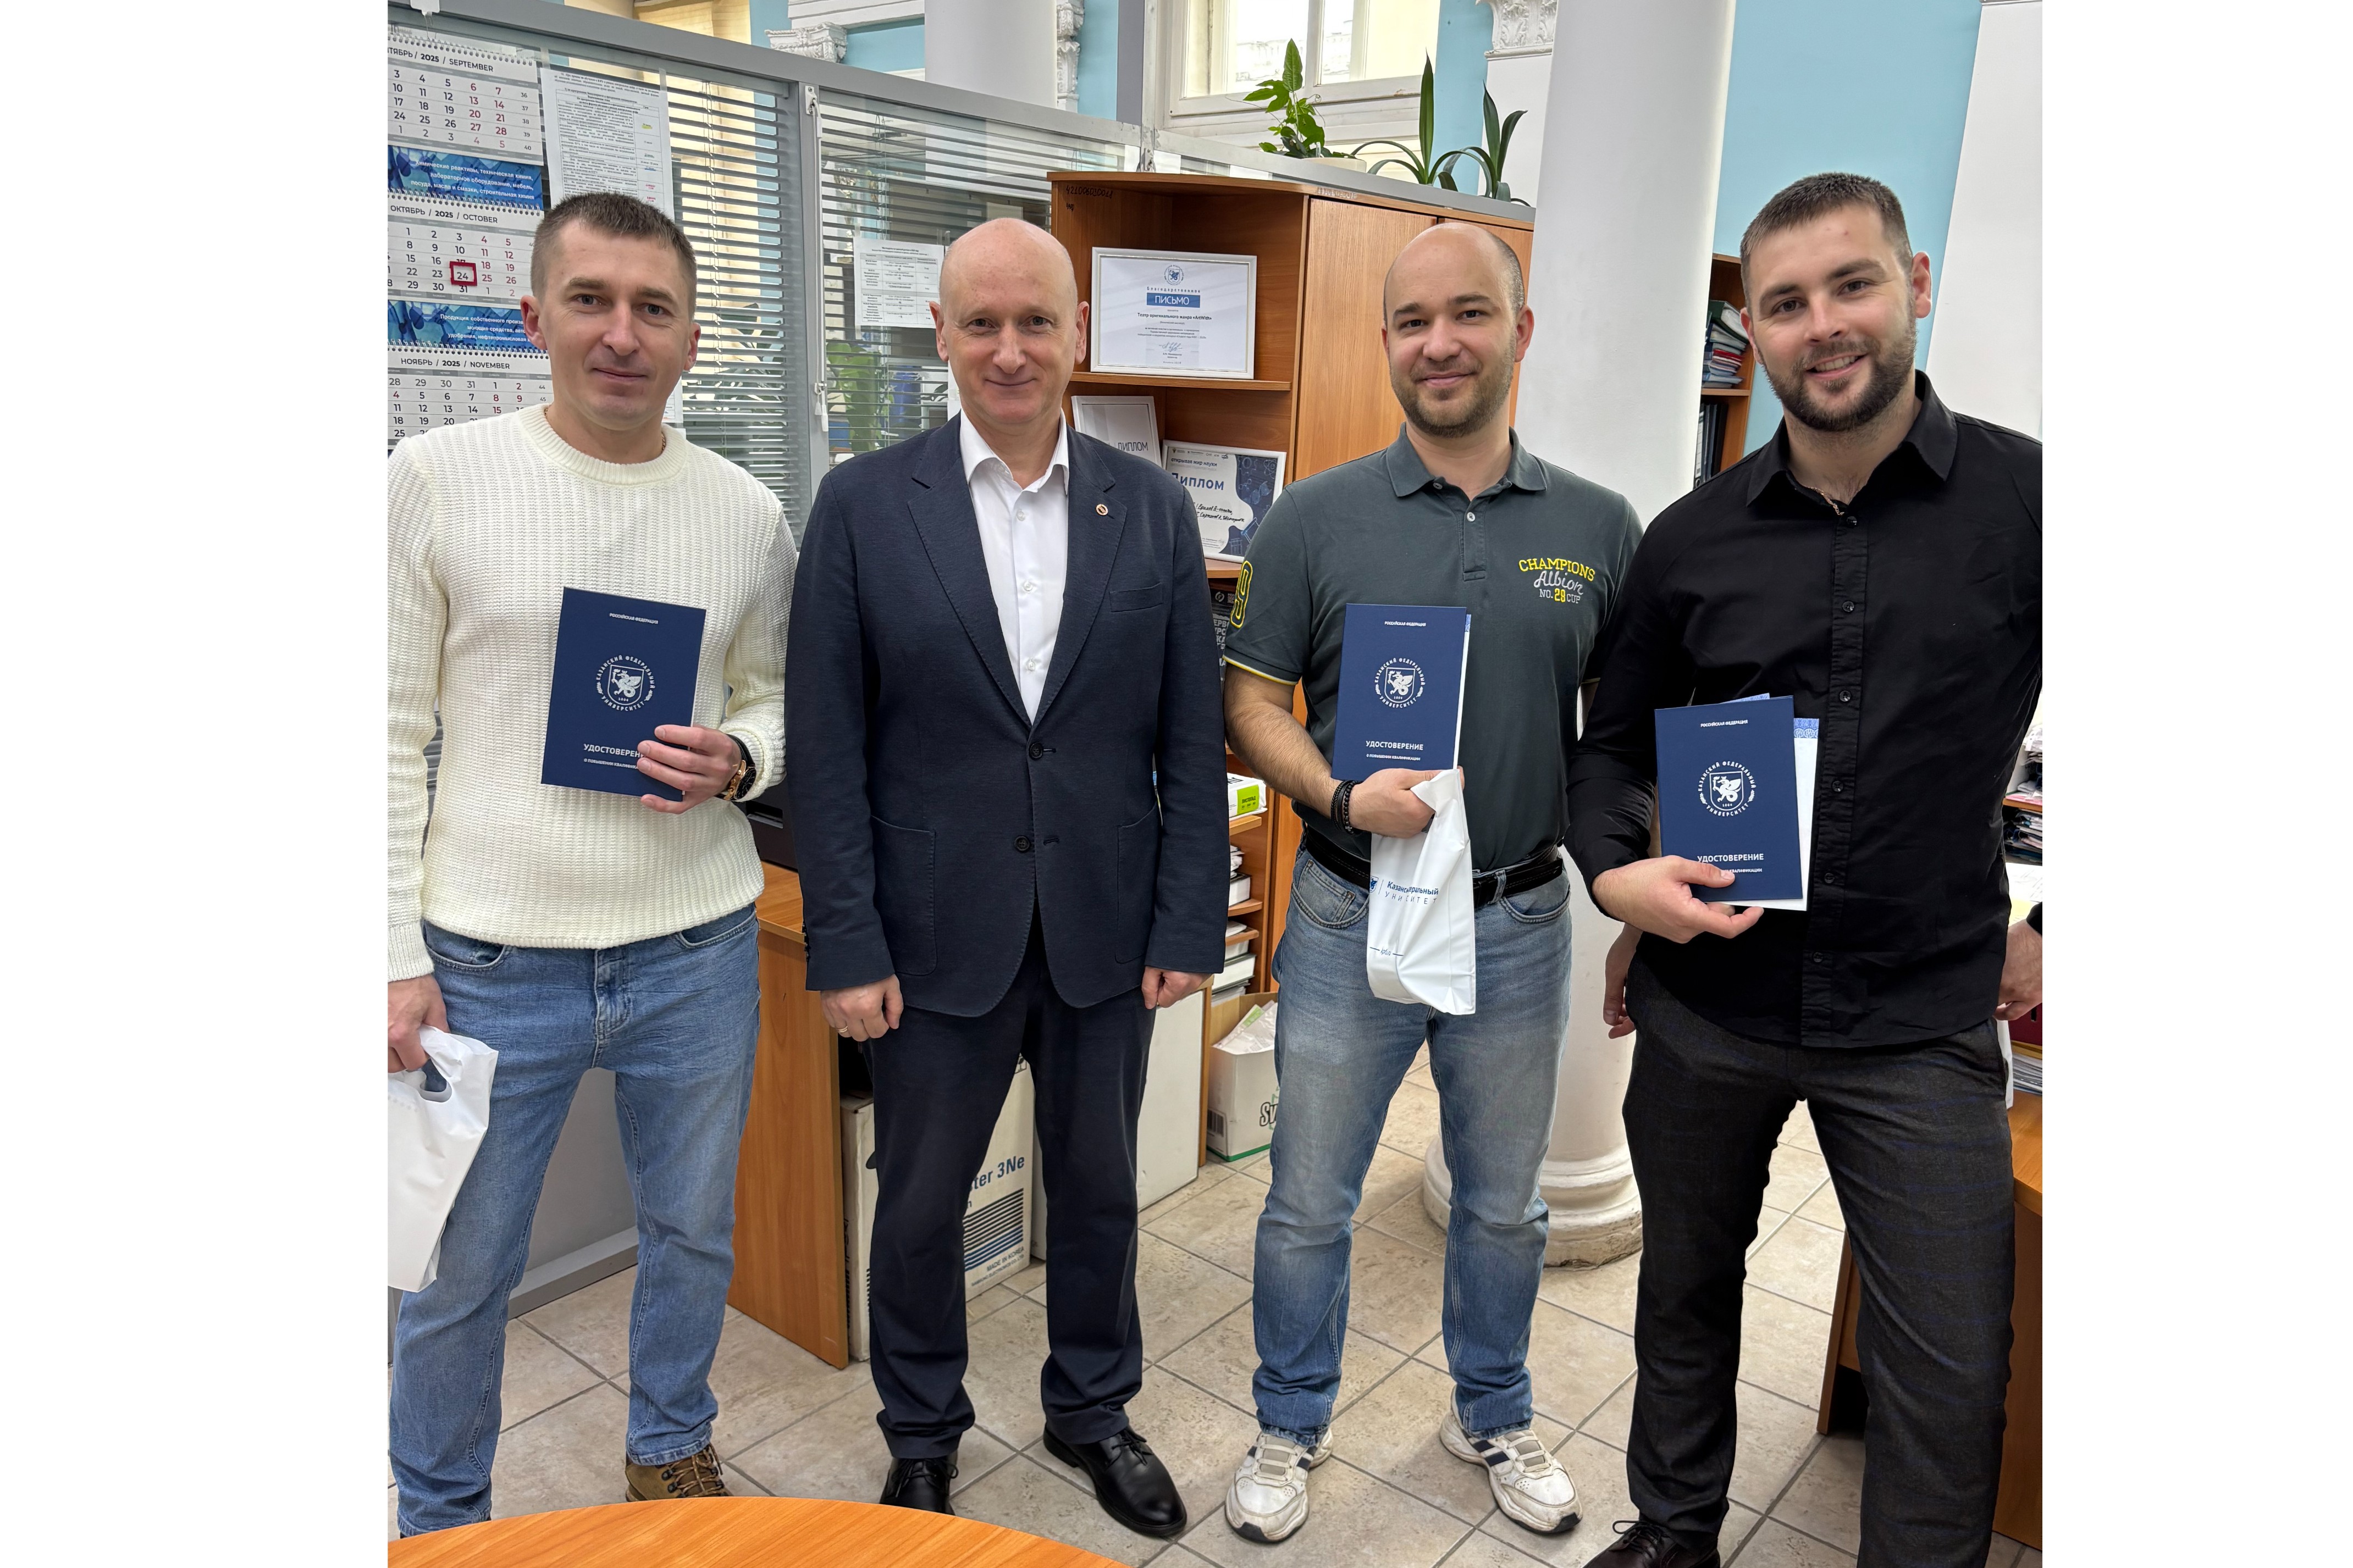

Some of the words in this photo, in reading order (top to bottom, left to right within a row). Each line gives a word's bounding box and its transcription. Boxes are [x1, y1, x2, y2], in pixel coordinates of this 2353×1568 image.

[421, 54, 439, 62] 2025
[449, 59, 493, 72] SEPTEMBER
[393, 84, 402, 92] 10
[419, 88, 426, 96] 11
[444, 92, 452, 101] 12
[470, 96, 478, 104] 13
[394, 97, 403, 106] 17
[419, 102, 428, 110] 18
[445, 106, 454, 114] 19
[496, 114, 504, 122] 21
[394, 111, 405, 120] 24
[420, 115, 430, 124] 25
[445, 119, 456, 128] 26
[416, 161, 450, 169] Химические
[451, 165, 479, 174] реактивы,
[480, 169, 514, 178] техническая
[411, 180, 432, 188] посуда,
[480, 189, 517, 198] строительная
[430, 173, 470, 182] лабораторное
[472, 177, 512, 188] оборудование,
[391, 206, 425, 214] ОКТЯБРЬ
[463, 214, 497, 223] OCTOBER
[1155, 295, 1190, 305] ПИСЬМО
[1518, 557, 1595, 581] CHAMPIONS
[1533, 570, 1584, 595] Albion
[1539, 589, 1553, 599] NO.
[1566, 594, 1581, 604] CUP
[596, 655, 623, 680] КАЗАНСКИЙ
[625, 656, 655, 689] ФЕДЕРАЛЬНЫЙ
[1374, 657, 1397, 683] КАЗАНСКИЙ
[1399, 658, 1426, 685] ФЕДЕРАЛЬНЫЙ
[601, 695, 645, 711] УНИВЕРСИТЕТ
[1379, 695, 1417, 708] УНИВЕРСИТЕТ
[1366, 740, 1423, 751] УДОСТОВЕРЕНИЕ
[1698, 762, 1720, 791] КАЗАНСКИЙ
[1722, 761, 1757, 788] ФЕДЕРАЛЬНЫЙ
[1706, 802, 1749, 817] УНИВЕРСИТЕТ
[1697, 853, 1764, 863] УДОСТОВЕРЕНИЕ
[997, 1155, 1025, 1178] 3Ne
